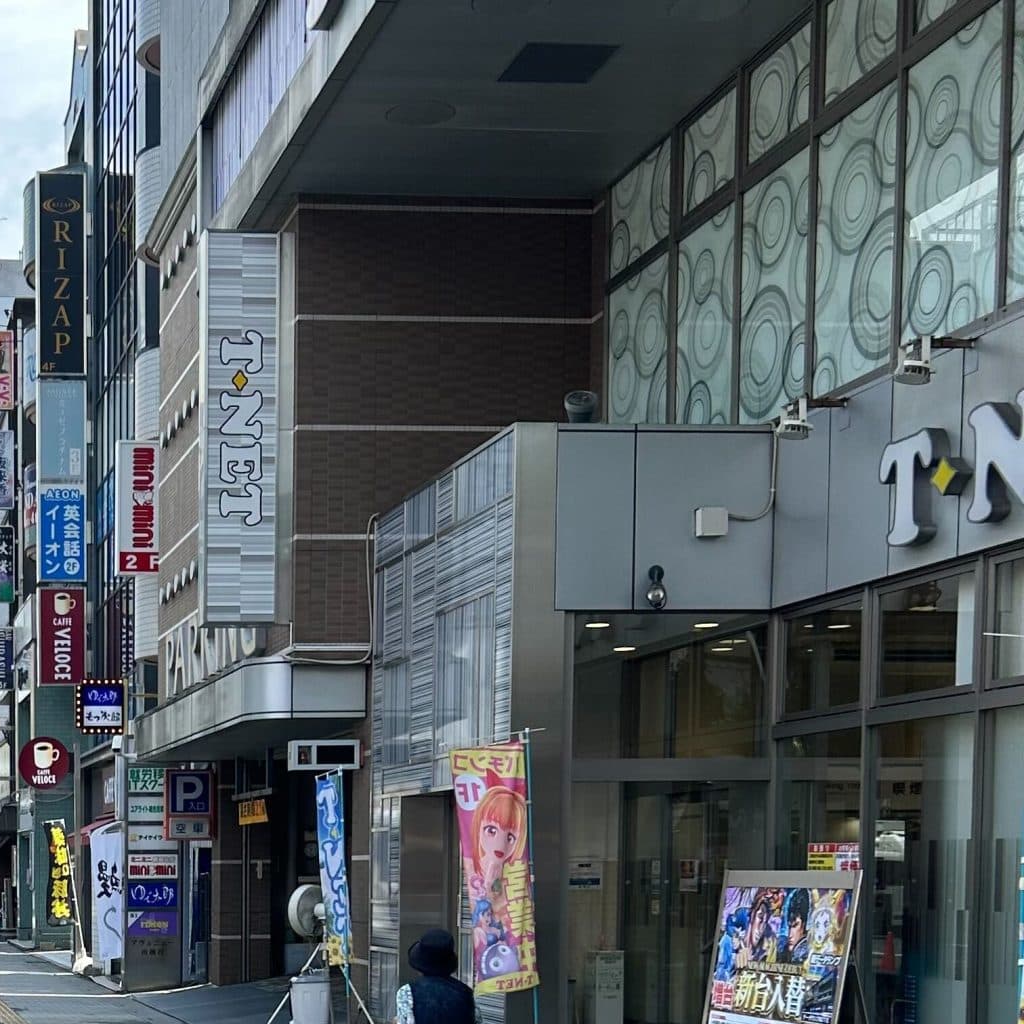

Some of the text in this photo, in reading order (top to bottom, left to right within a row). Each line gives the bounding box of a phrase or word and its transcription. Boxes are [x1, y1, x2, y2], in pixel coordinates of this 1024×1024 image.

[52, 220, 72, 355] RIZAP
[41, 363, 56, 372] 4F
[45, 489, 80, 500] AEON
[46, 505, 61, 575] イーオン
[63, 505, 80, 557] 英会話
[53, 618, 72, 626] CAFFE
[54, 628, 71, 681] VELOCE
[32, 774, 56, 784] VELOCE
[176, 776, 204, 812] P
[189, 801, 205, 810] 入口
[176, 823, 203, 834] 空車
[736, 970, 807, 1019] 新台入替
